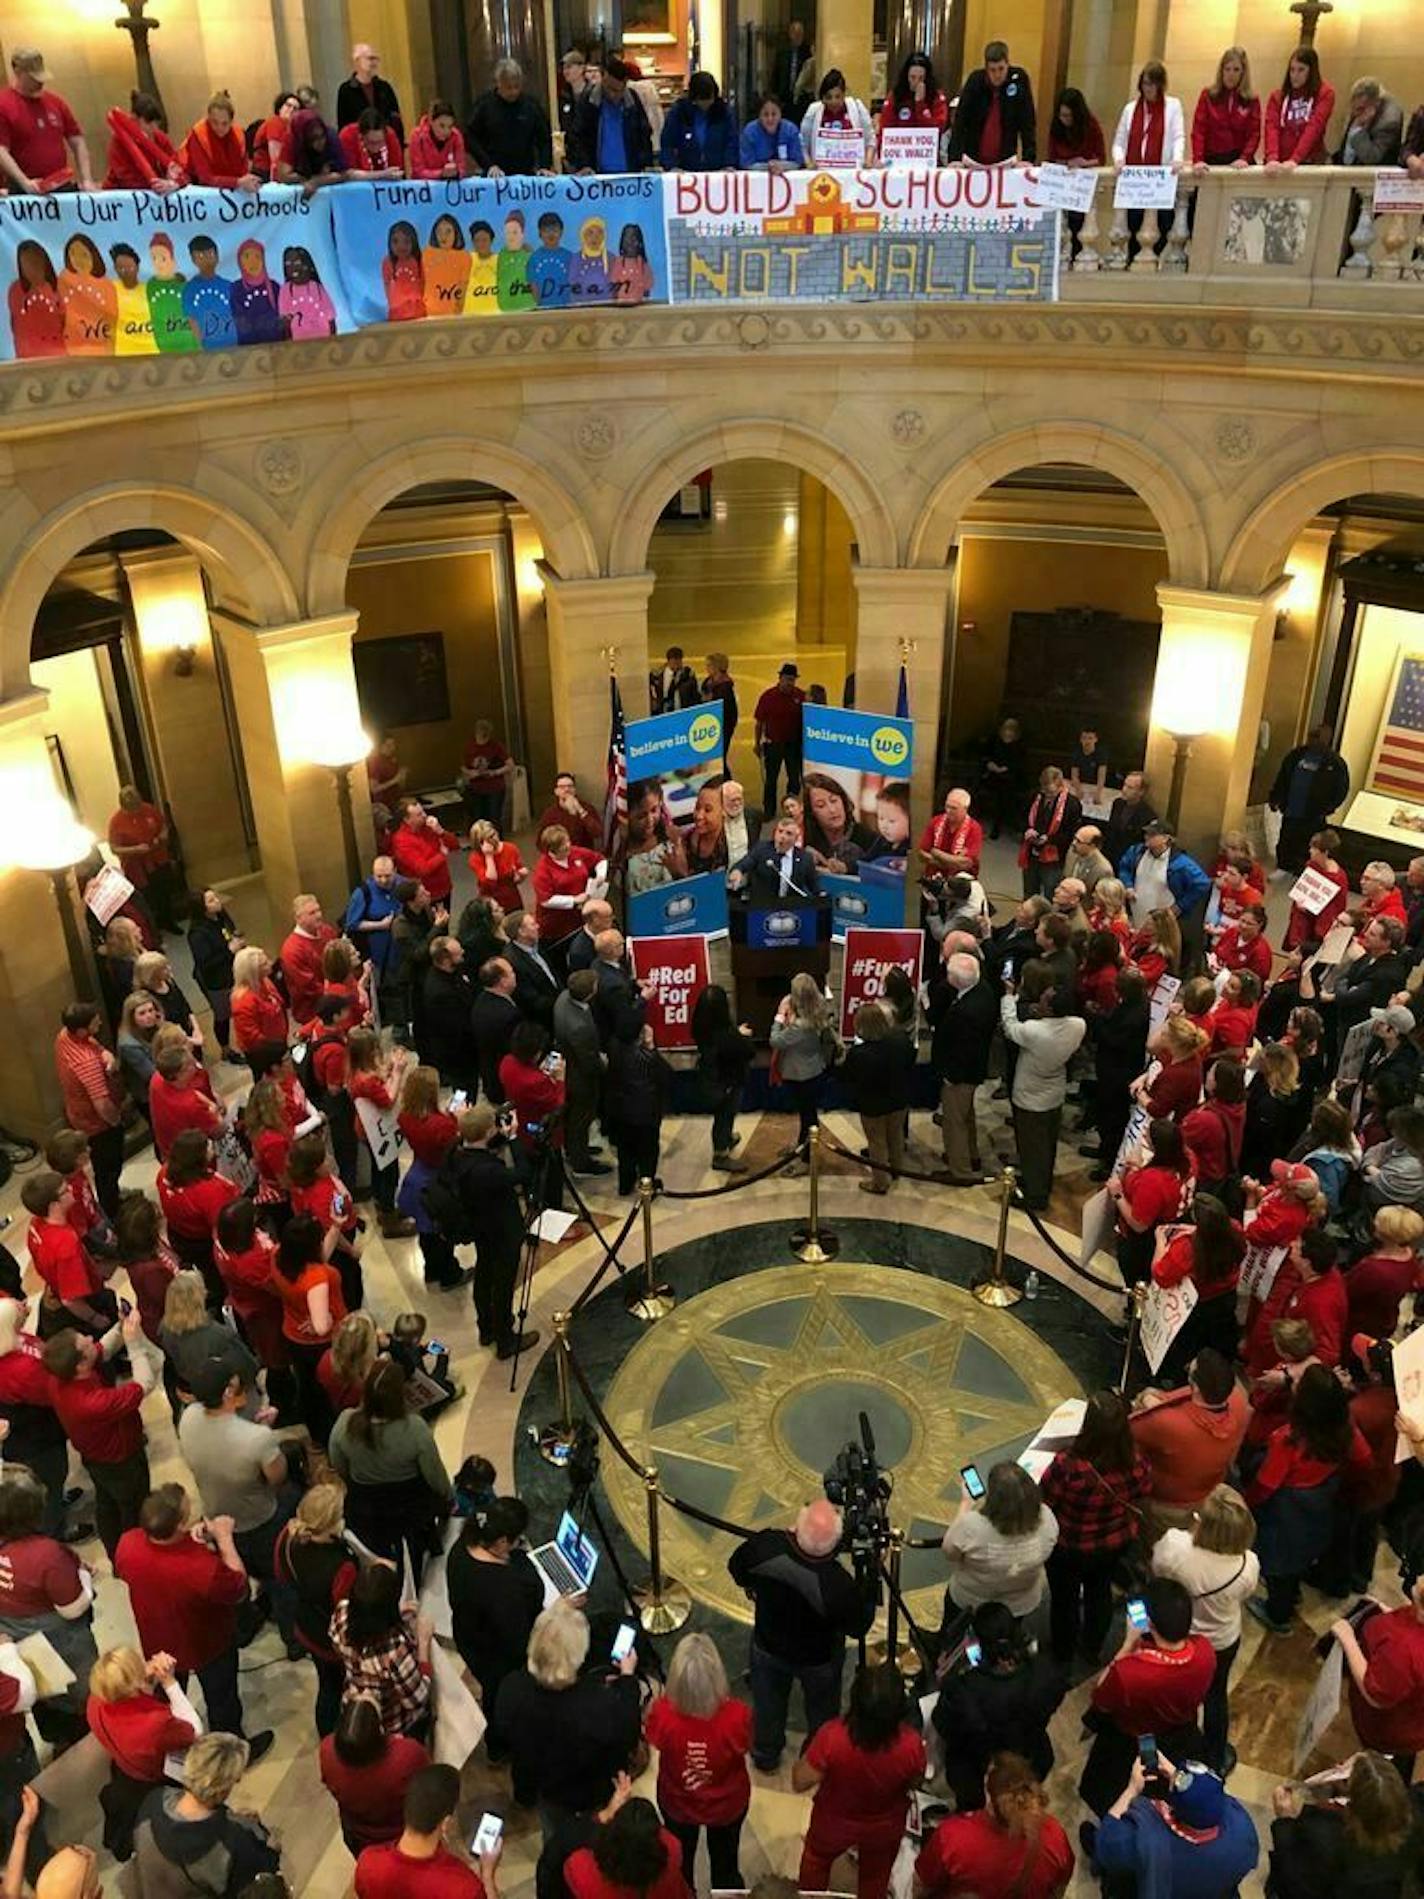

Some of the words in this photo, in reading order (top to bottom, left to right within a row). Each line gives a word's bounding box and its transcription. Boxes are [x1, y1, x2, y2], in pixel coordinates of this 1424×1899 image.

[373, 182, 432, 210] Fund
[444, 178, 487, 206] Our
[496, 179, 556, 204] Public
[566, 177, 654, 201] Schools
[677, 173, 791, 214] BUILD
[0, 196, 60, 226] und
[77, 194, 123, 225] Our
[132, 191, 207, 225] Public
[219, 189, 310, 223] Schools
[689, 247, 808, 297] NOT
[842, 244, 1043, 294] WALLS
[436, 284, 463, 300] We
[473, 284, 500, 297] are
[509, 278, 533, 296] the
[541, 277, 631, 299] Dream
[82, 318, 111, 338] We
[693, 724, 716, 742] we
[806, 727, 855, 746] believe
[855, 734, 869, 748] in
[630, 739, 674, 758] believe
[674, 734, 689, 746] in
[876, 739, 904, 754] we
[648, 963, 696, 986] #Red
[659, 986, 691, 1005] For
[664, 1004, 688, 1025] Ed
